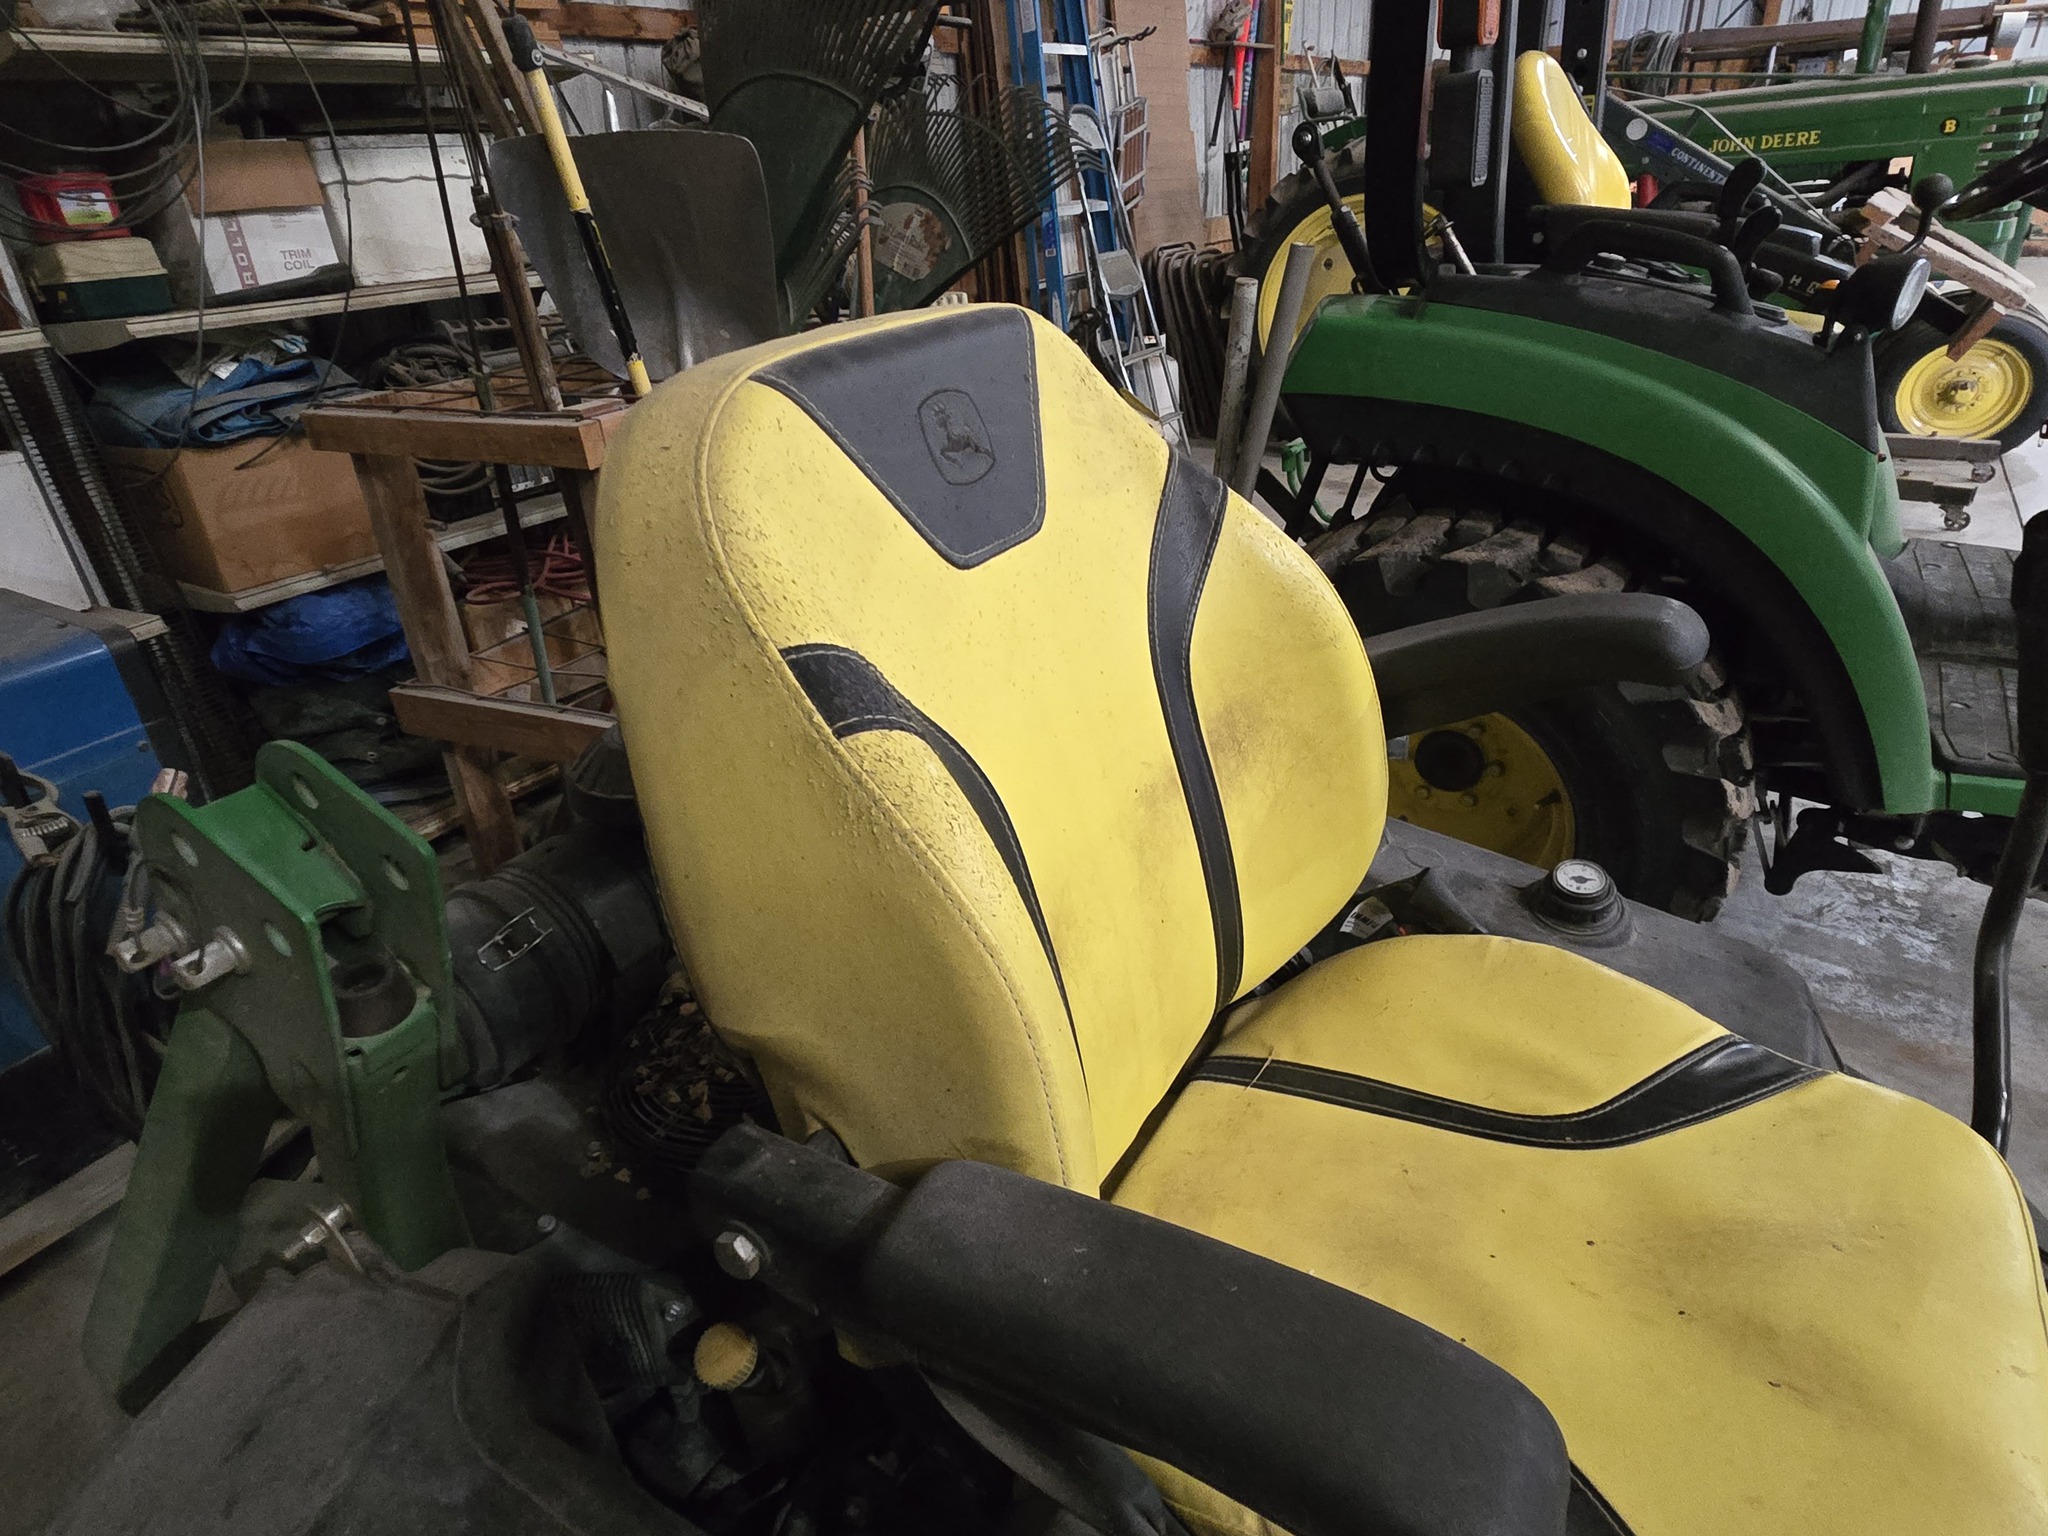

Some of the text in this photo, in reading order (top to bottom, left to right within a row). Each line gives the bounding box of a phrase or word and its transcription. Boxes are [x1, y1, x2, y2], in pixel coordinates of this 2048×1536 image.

[1944, 119, 1957, 133] B
[1708, 130, 1821, 153] JOHN DEERE
[1671, 147, 1728, 186] CONTINENTA
[280, 248, 312, 260] TRIM
[284, 260, 315, 271] COIL
